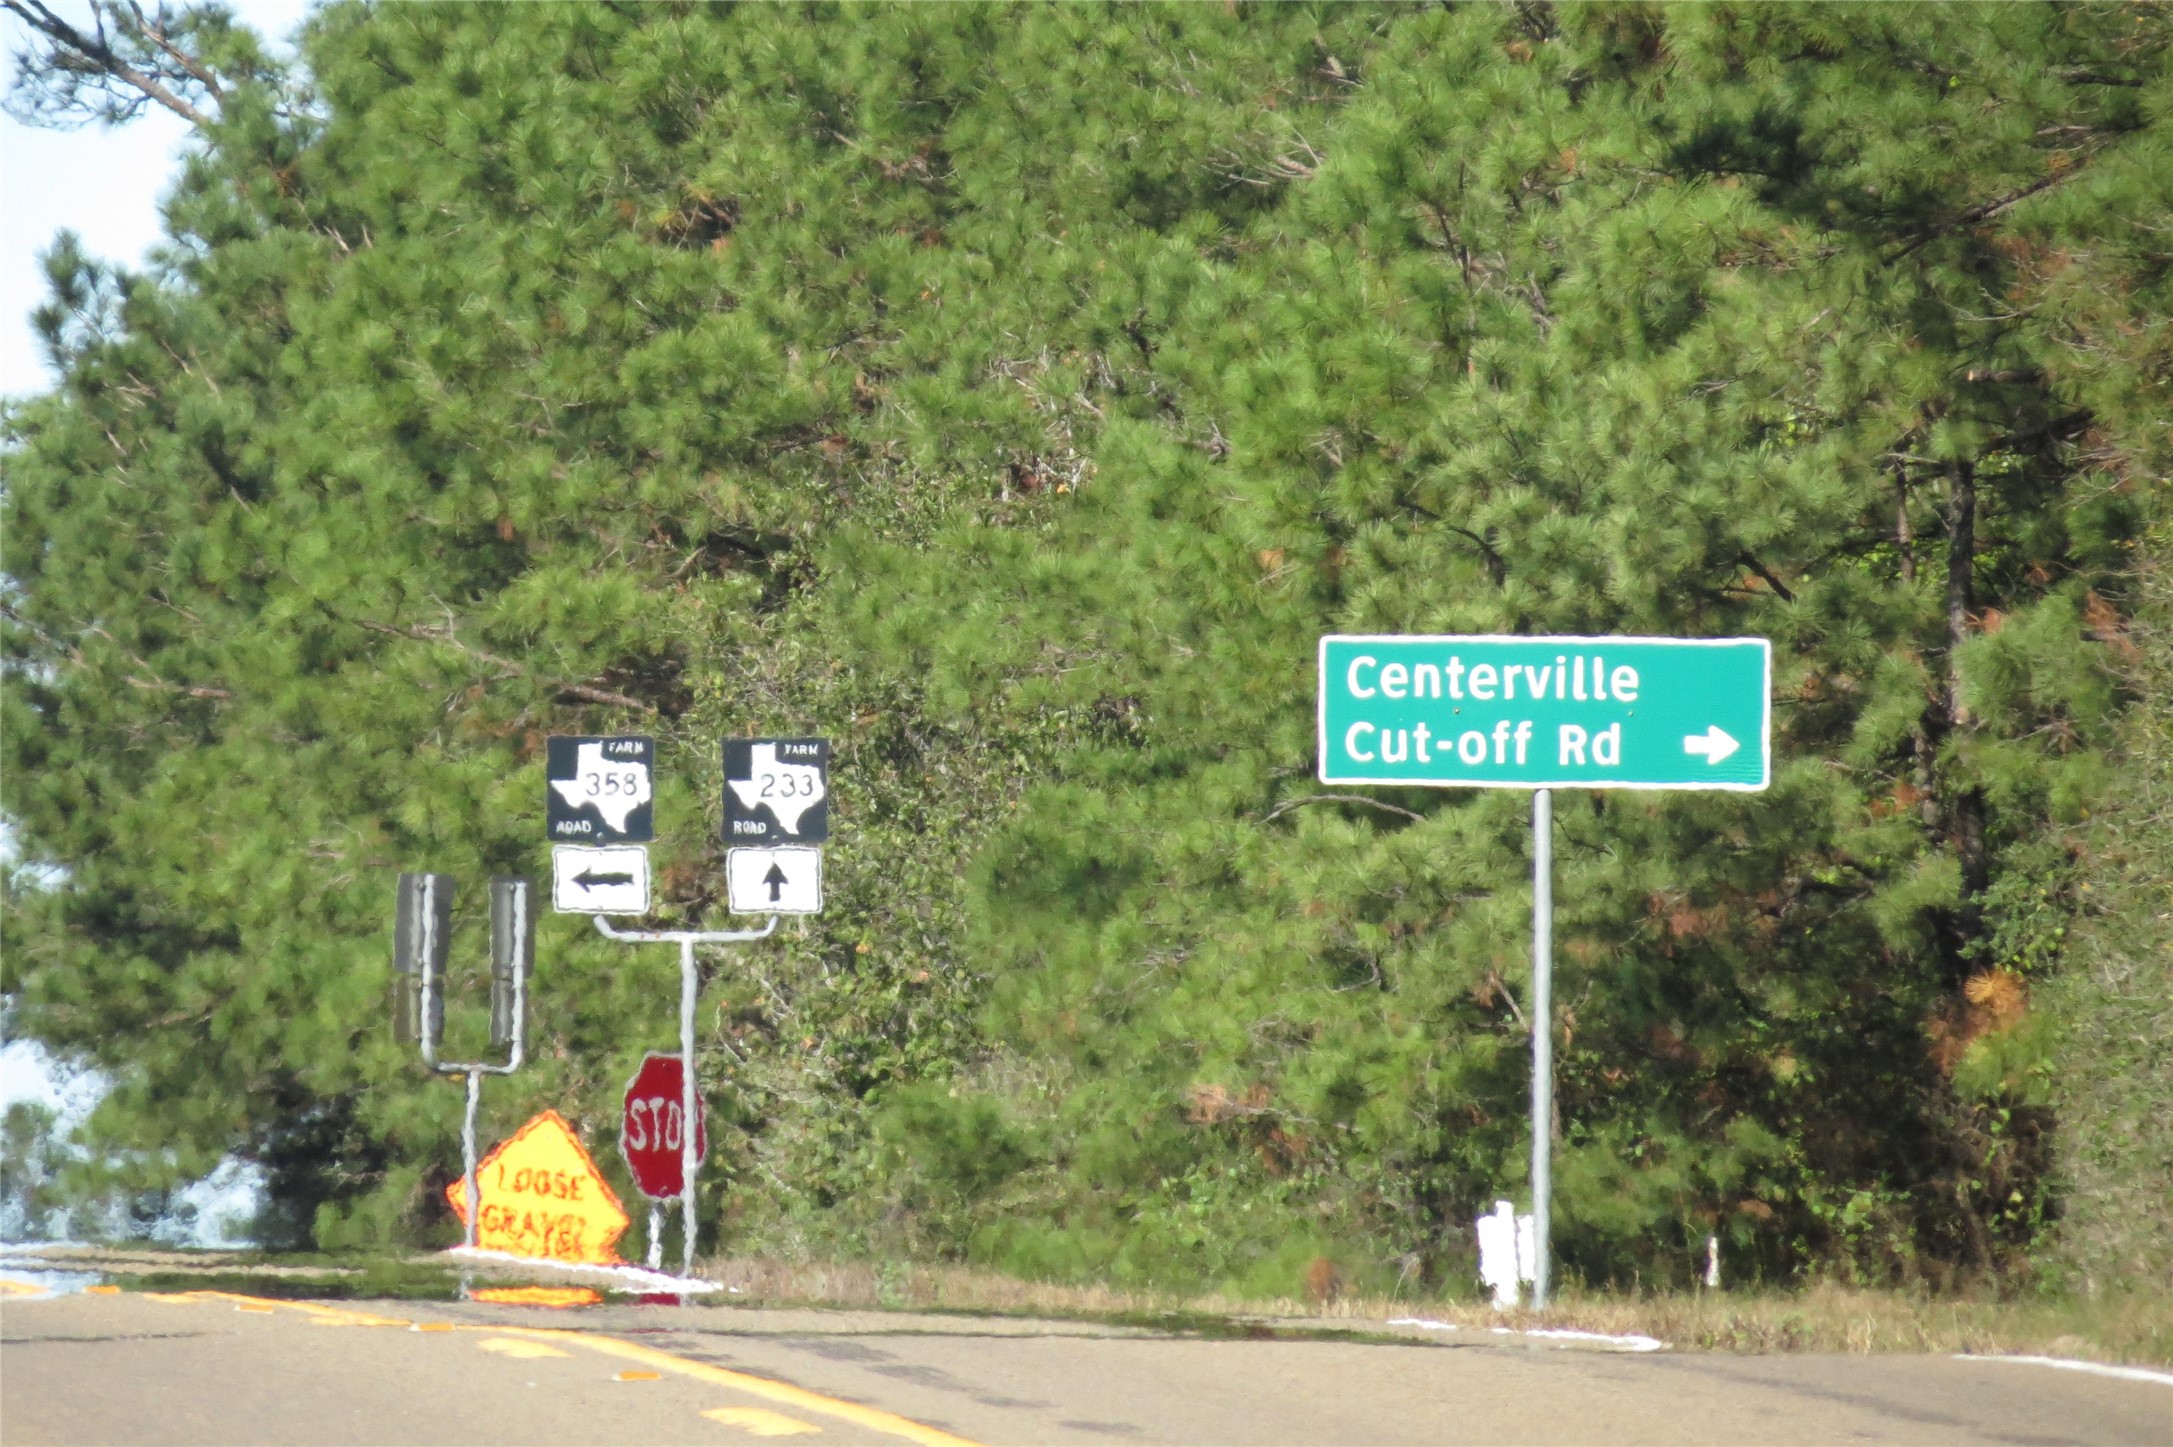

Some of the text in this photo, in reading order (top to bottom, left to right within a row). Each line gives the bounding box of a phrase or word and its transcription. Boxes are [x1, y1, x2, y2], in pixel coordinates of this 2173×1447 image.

[1346, 655, 1639, 701] Centerville
[608, 742, 645, 754] FARM
[785, 744, 819, 755] FARM
[1345, 720, 1621, 765] Cut-off Rd
[585, 772, 638, 796] 358
[760, 774, 814, 798] 233
[556, 820, 592, 833] ROAD
[733, 820, 767, 834] ROAD
[629, 1097, 698, 1151] STO
[498, 1163, 586, 1200] LOOSE
